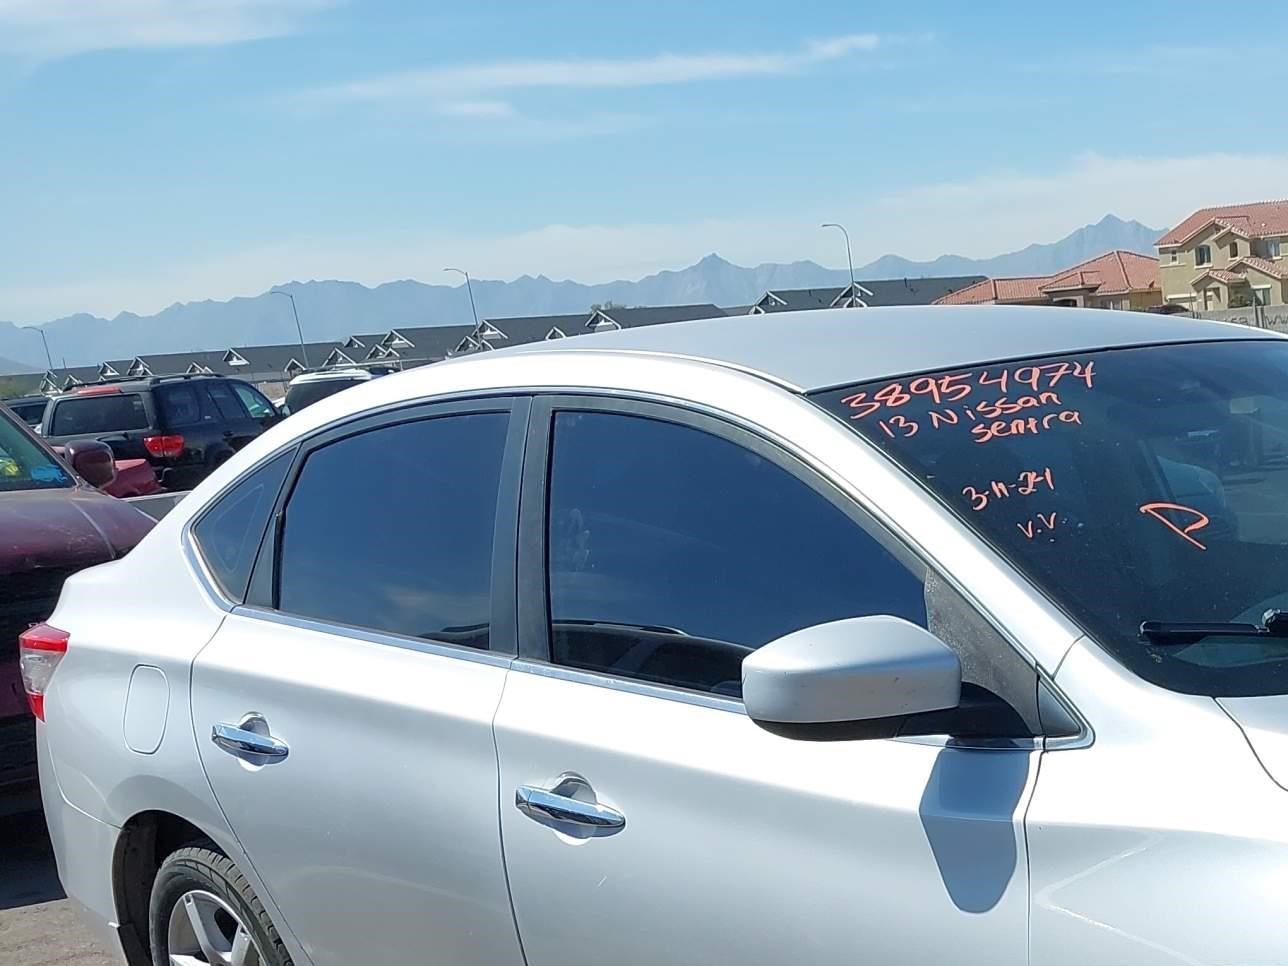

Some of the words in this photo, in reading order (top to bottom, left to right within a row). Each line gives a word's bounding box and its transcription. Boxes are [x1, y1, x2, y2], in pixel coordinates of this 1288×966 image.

[840, 361, 1096, 419] 38954974
[879, 415, 919, 438] 13
[929, 391, 1061, 430] Nissan
